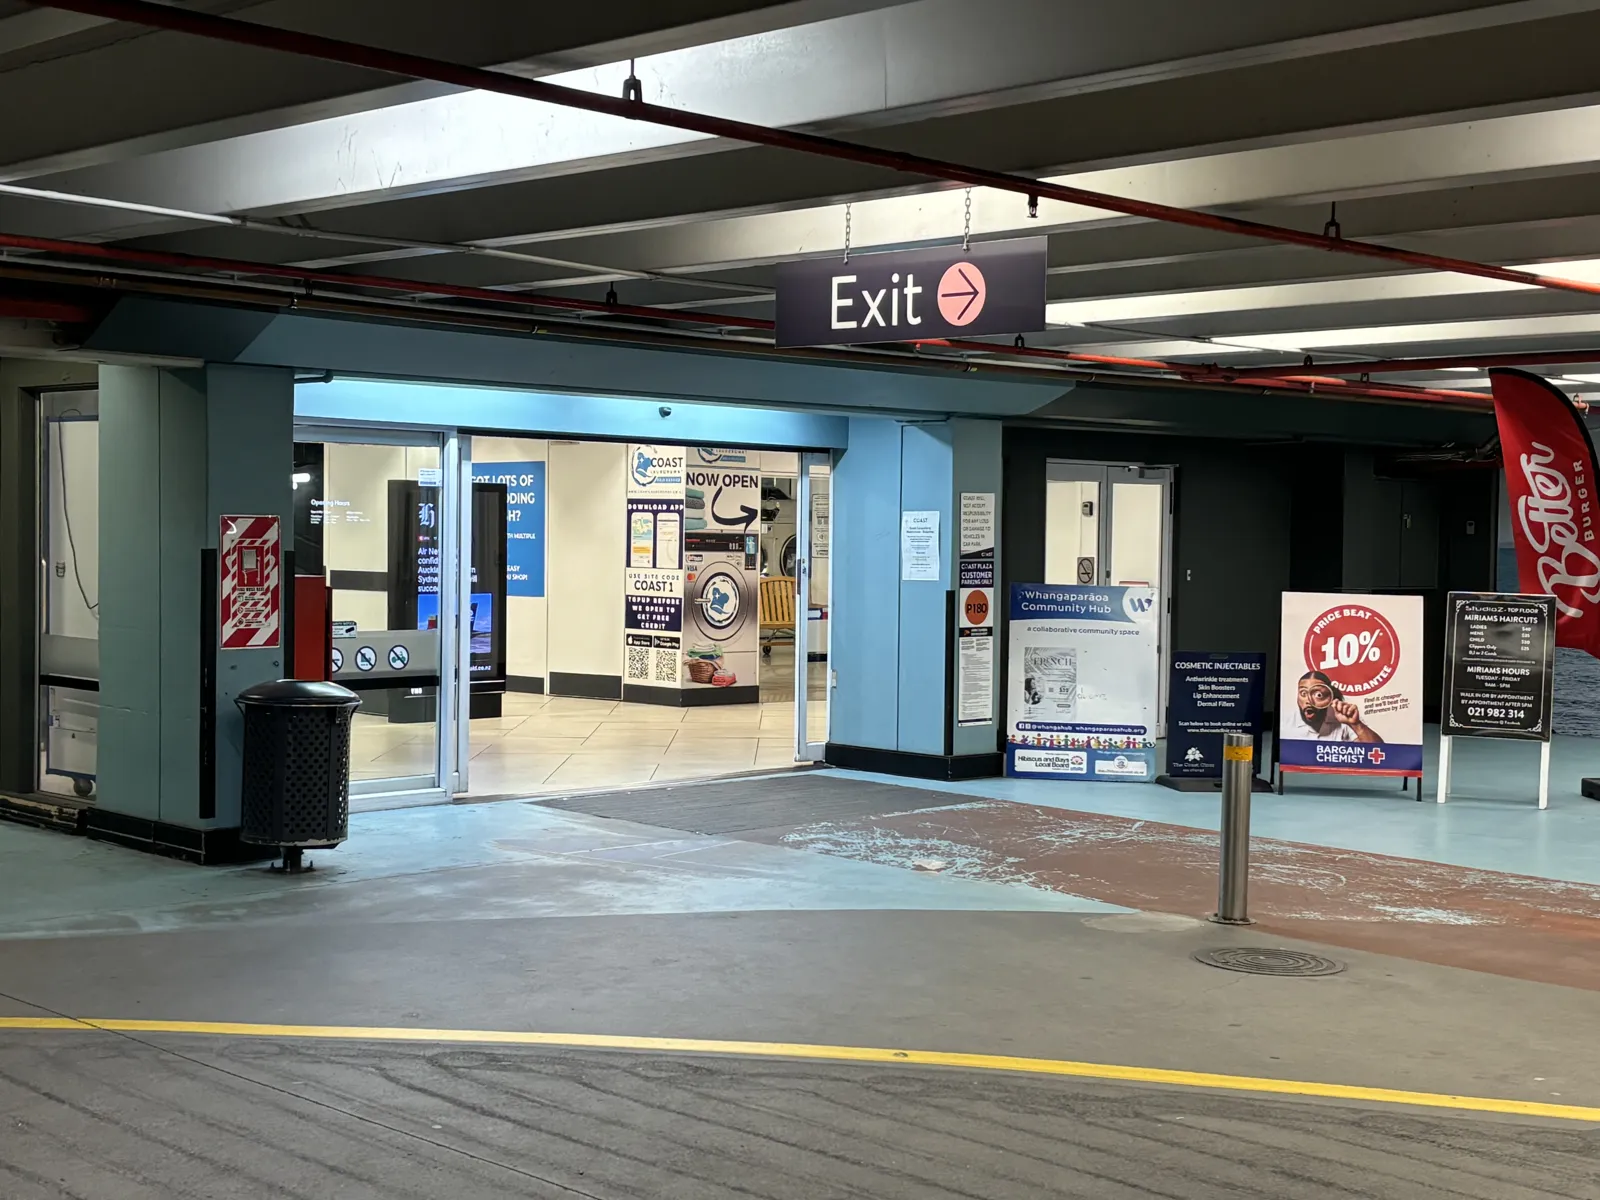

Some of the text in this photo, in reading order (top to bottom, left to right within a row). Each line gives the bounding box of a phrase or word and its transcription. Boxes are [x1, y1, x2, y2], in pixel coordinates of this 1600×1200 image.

[831, 273, 922, 330] Exit
[651, 457, 684, 468] COAST
[519, 474, 534, 487] OF
[686, 472, 719, 486] NOW
[722, 474, 758, 488] OPEN
[1573, 459, 1595, 542] BURGER
[1518, 442, 1600, 618] Better
[653, 597, 680, 605] BEFORE
[1025, 591, 1109, 602] Whangaparāoa
[966, 603, 987, 613] P180
[1021, 603, 1111, 614] Community Hub
[1313, 608, 1372, 634] PRICE BEAT
[1465, 614, 1538, 624] MIRIAMS HAIRCUTS
[641, 622, 665, 630] CREDIT
[1033, 626, 1077, 634] collaborative
[1467, 666, 1500, 674] MIRIAMS
[1330, 665, 1392, 693] GUARANTEE
[1467, 707, 1525, 719] 021 982 314
[1316, 745, 1365, 755] BARGAIN
[1316, 754, 1365, 764] CHEMIST
